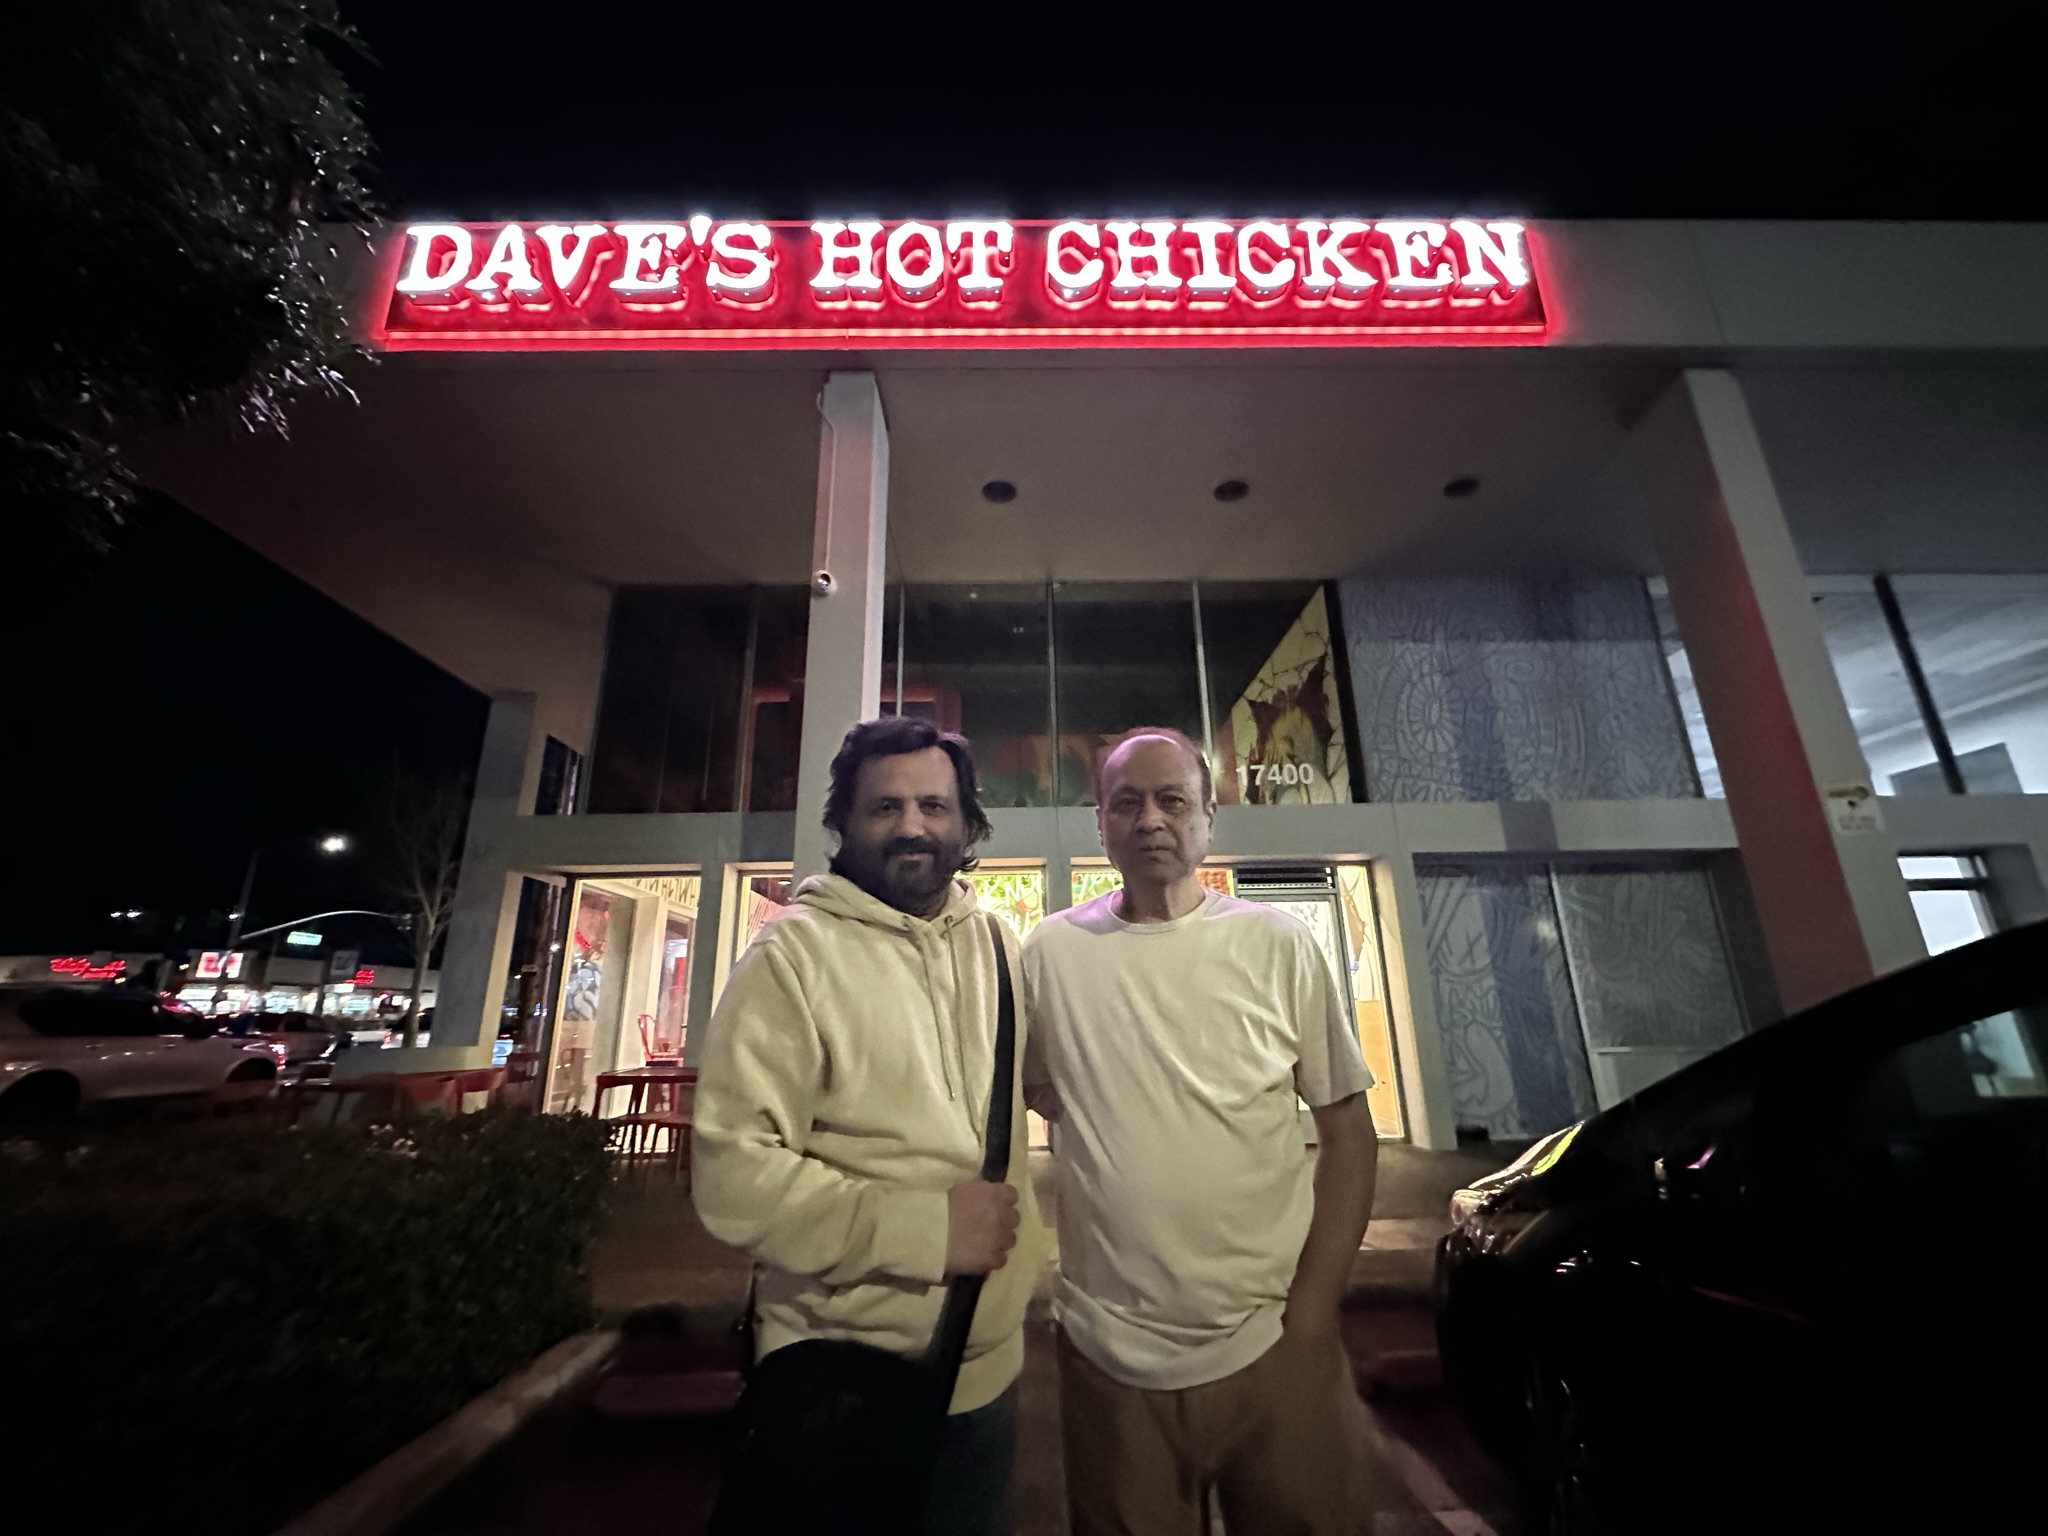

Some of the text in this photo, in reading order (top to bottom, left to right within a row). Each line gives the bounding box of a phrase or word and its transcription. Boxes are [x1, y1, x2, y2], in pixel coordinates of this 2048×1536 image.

[396, 214, 1531, 293] DAVE'S HOT CHICKEN
[1235, 763, 1314, 786] 17400
